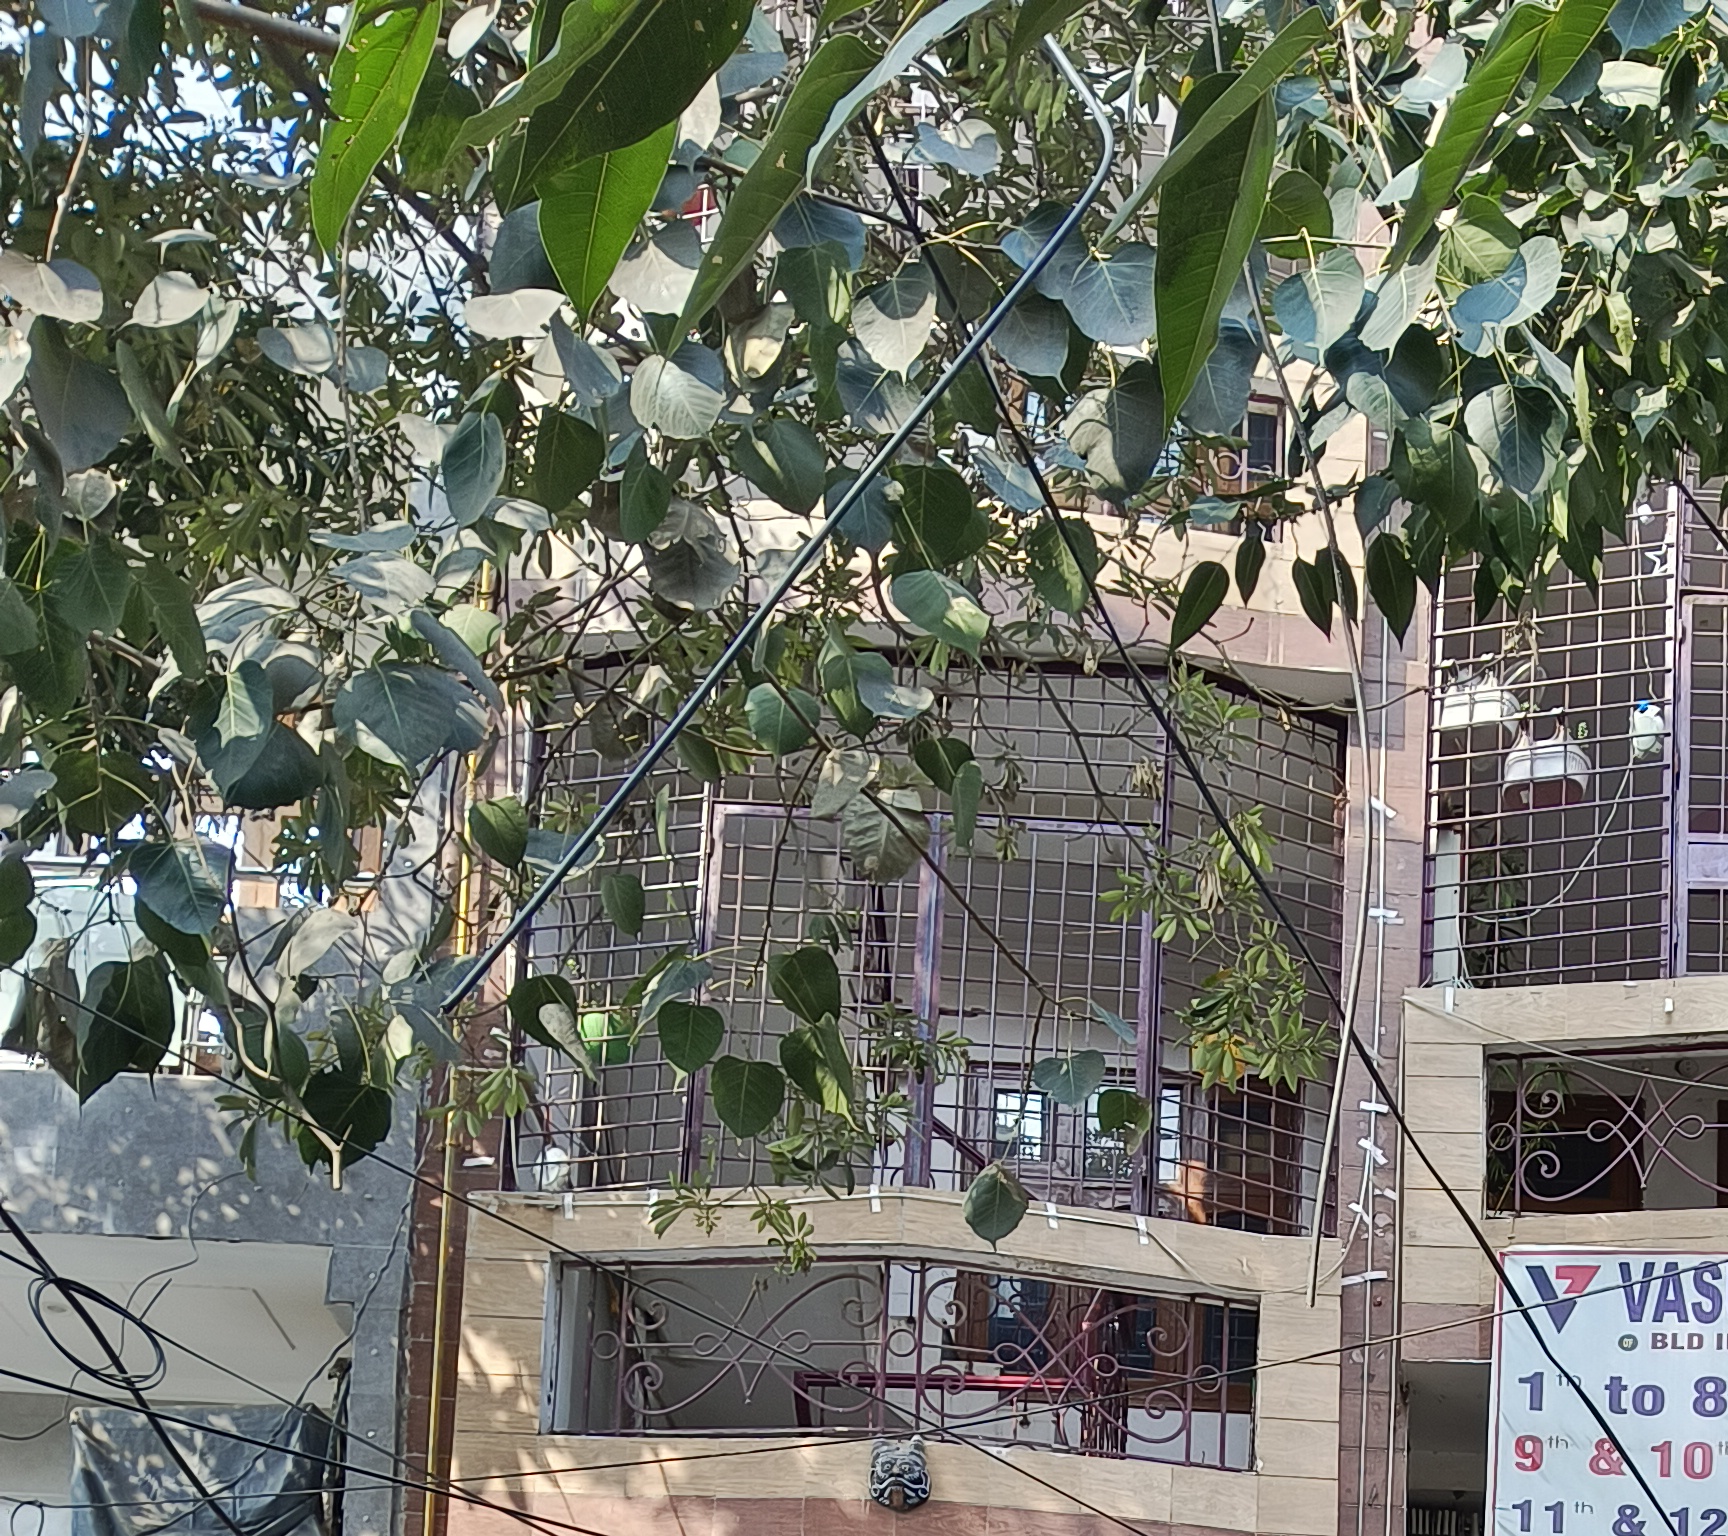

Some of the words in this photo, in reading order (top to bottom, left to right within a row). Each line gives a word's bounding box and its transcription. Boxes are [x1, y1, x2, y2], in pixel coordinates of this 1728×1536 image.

[1651, 1333, 1704, 1350] BLD
[1604, 1375, 1665, 1417] to
[1588, 1437, 1626, 1476] &
